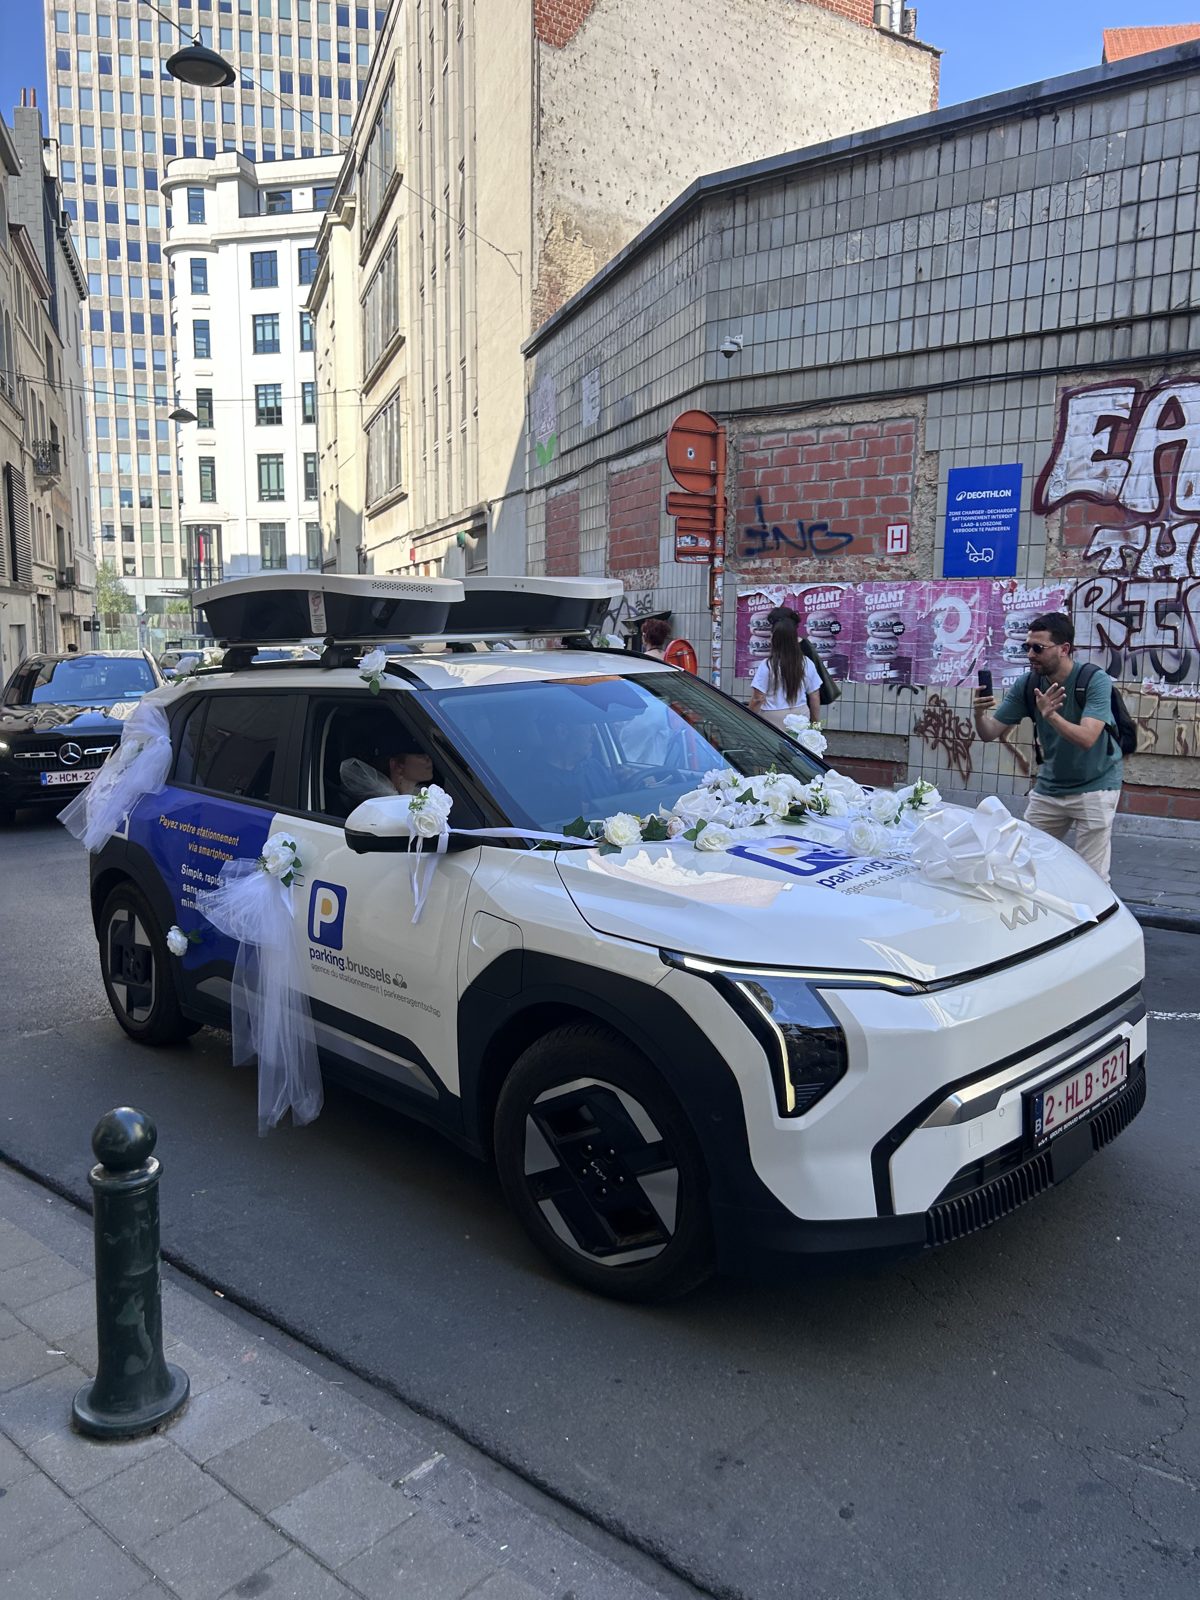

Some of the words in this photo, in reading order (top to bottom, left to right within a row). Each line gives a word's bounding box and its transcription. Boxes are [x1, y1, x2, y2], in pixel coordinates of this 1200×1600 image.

[966, 489, 1012, 500] DECATHLON
[987, 507, 1017, 515] DECHARGER
[803, 589, 842, 605] GIANT
[864, 589, 906, 605] GIANT
[1001, 589, 1047, 605] GIANT
[1014, 598, 1048, 610] GRATUIT
[804, 605, 816, 613] 1+1
[816, 600, 841, 610] GRATIS
[875, 600, 905, 611] GRATUIT
[159, 814, 178, 830] Payez
[178, 822, 196, 834] votre
[196, 827, 240, 847] stationnement
[188, 841, 198, 853] via
[198, 846, 234, 862] smartphone
[181, 863, 204, 881] Simple,
[312, 886, 340, 939] P
[309, 947, 392, 985] parking.brussels
[310, 963, 331, 975] agence
[338, 972, 380, 994] stationnement
[1034, 1117, 1042, 1134] B
